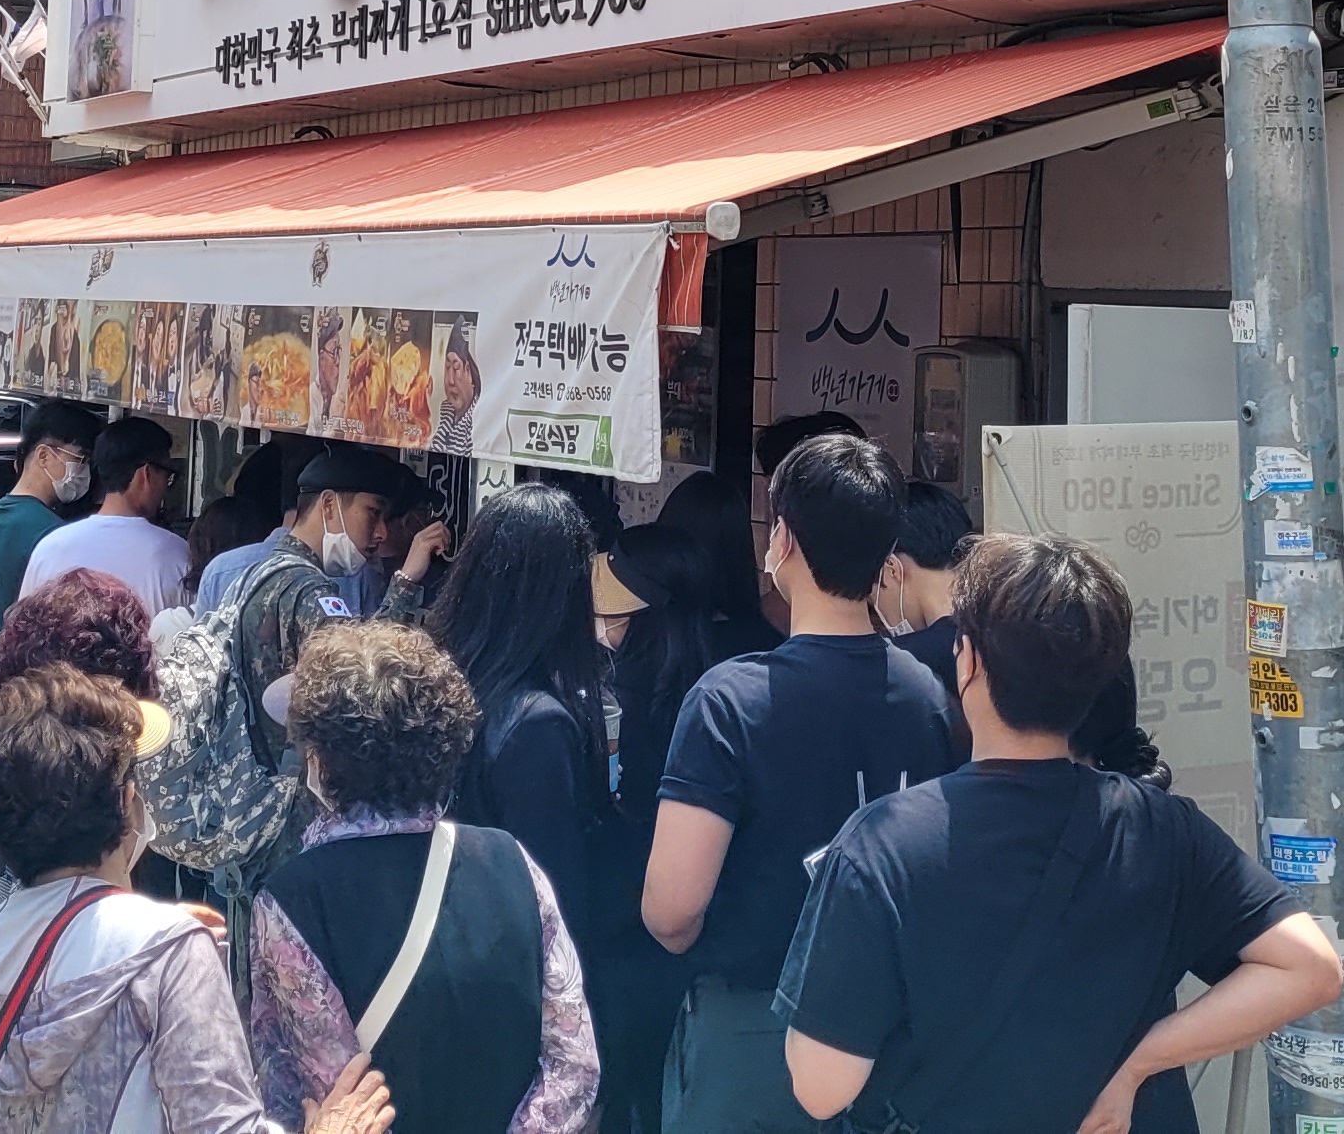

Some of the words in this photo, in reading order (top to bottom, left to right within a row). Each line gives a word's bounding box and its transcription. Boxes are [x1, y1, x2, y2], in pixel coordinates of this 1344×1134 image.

[215, 25, 280, 89] 대한민국
[285, 19, 323, 69] 최초
[522, 381, 554, 401] 고객센터
[527, 420, 580, 455] 오뎅식당
